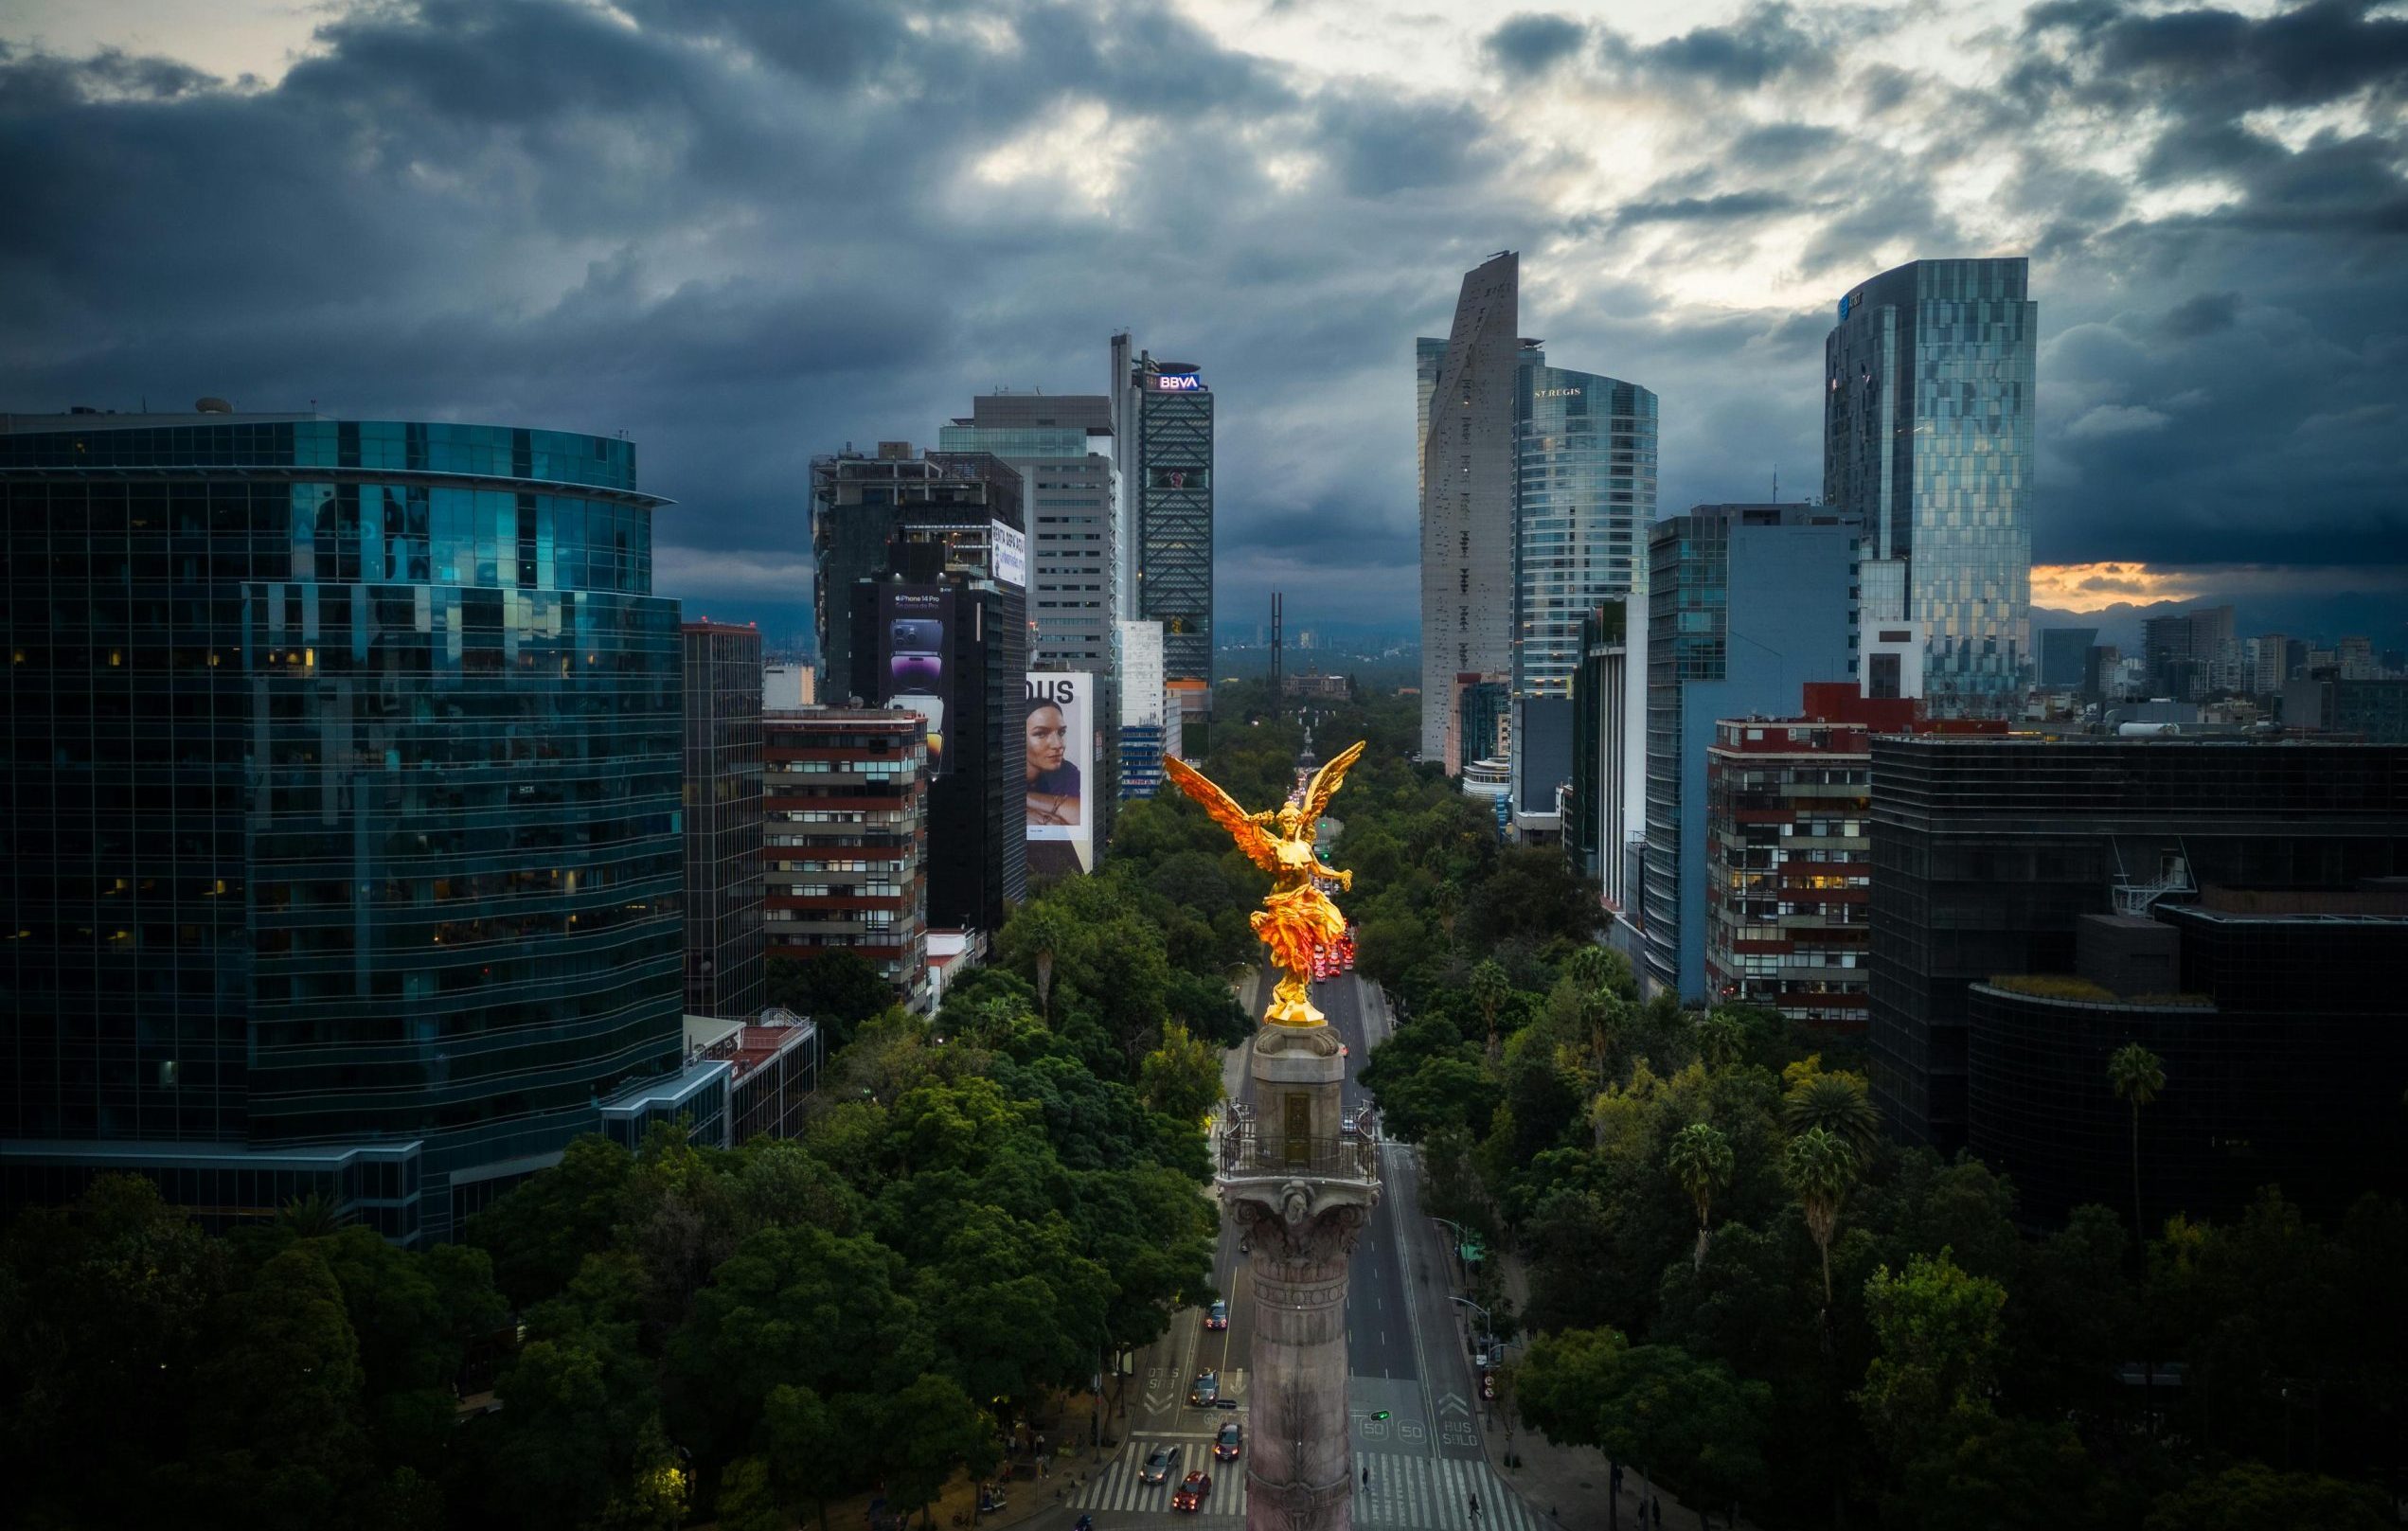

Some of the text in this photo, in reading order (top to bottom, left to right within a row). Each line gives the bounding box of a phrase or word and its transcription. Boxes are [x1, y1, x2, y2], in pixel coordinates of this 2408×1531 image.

[1160, 376, 1198, 388] BBVA
[1548, 387, 1580, 397] REGIS
[1364, 1423, 1383, 1435] 50
[1401, 1426, 1422, 1438] 50
[1445, 1420, 1472, 1433] BUS
